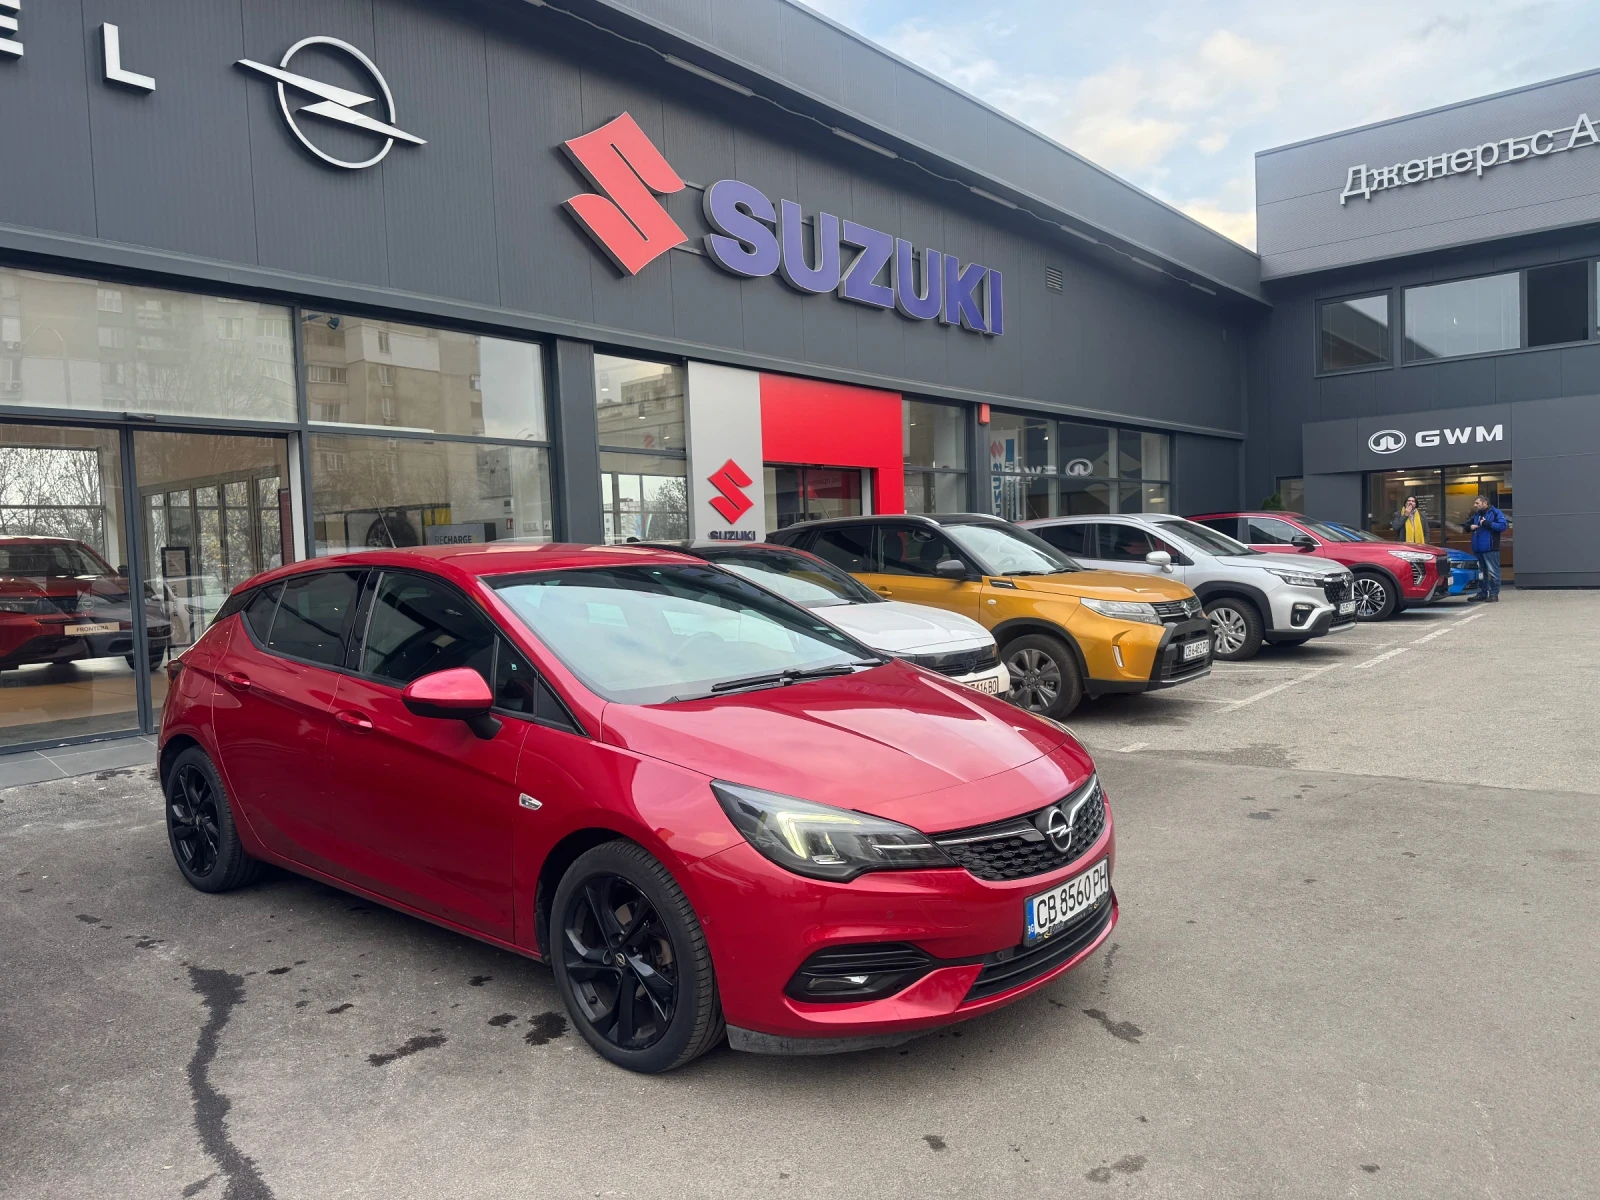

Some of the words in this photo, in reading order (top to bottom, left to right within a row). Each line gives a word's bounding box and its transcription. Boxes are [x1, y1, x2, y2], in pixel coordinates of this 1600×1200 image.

[1340, 130, 1554, 205] Дженеръс
[703, 179, 1004, 336] SUZUKI
[1415, 424, 1503, 447] GWM
[435, 535, 472, 544] RECHARGE
[707, 530, 756, 541] SUZUKI
[1037, 894, 1057, 929] CB
[1060, 874, 1091, 917] 8560
[1093, 862, 1107, 897] PH
